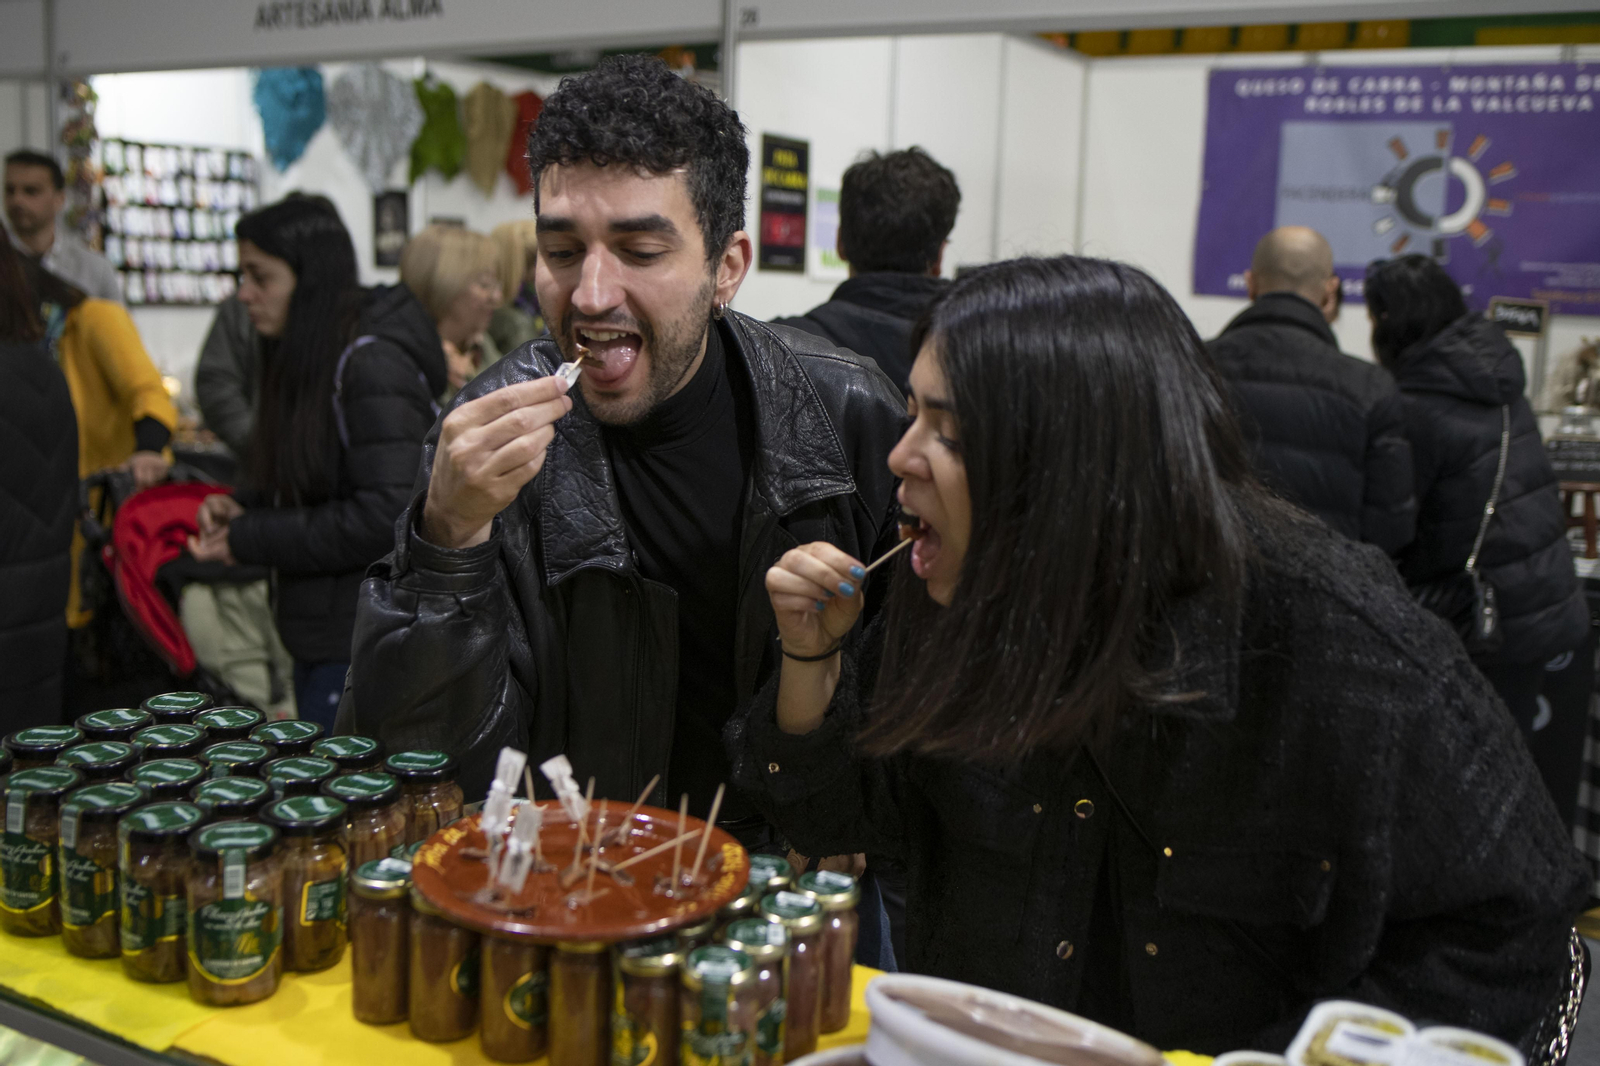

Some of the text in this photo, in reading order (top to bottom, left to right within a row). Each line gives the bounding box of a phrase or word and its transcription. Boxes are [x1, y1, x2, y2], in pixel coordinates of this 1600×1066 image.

[1235, 77, 1305, 98] QUESO
[1311, 75, 1341, 96] DE
[1347, 75, 1422, 96] CABRA
[1448, 71, 1564, 93] MONTAÑA
[1304, 94, 1594, 114] ROBLES DE LA VALCUEVA
